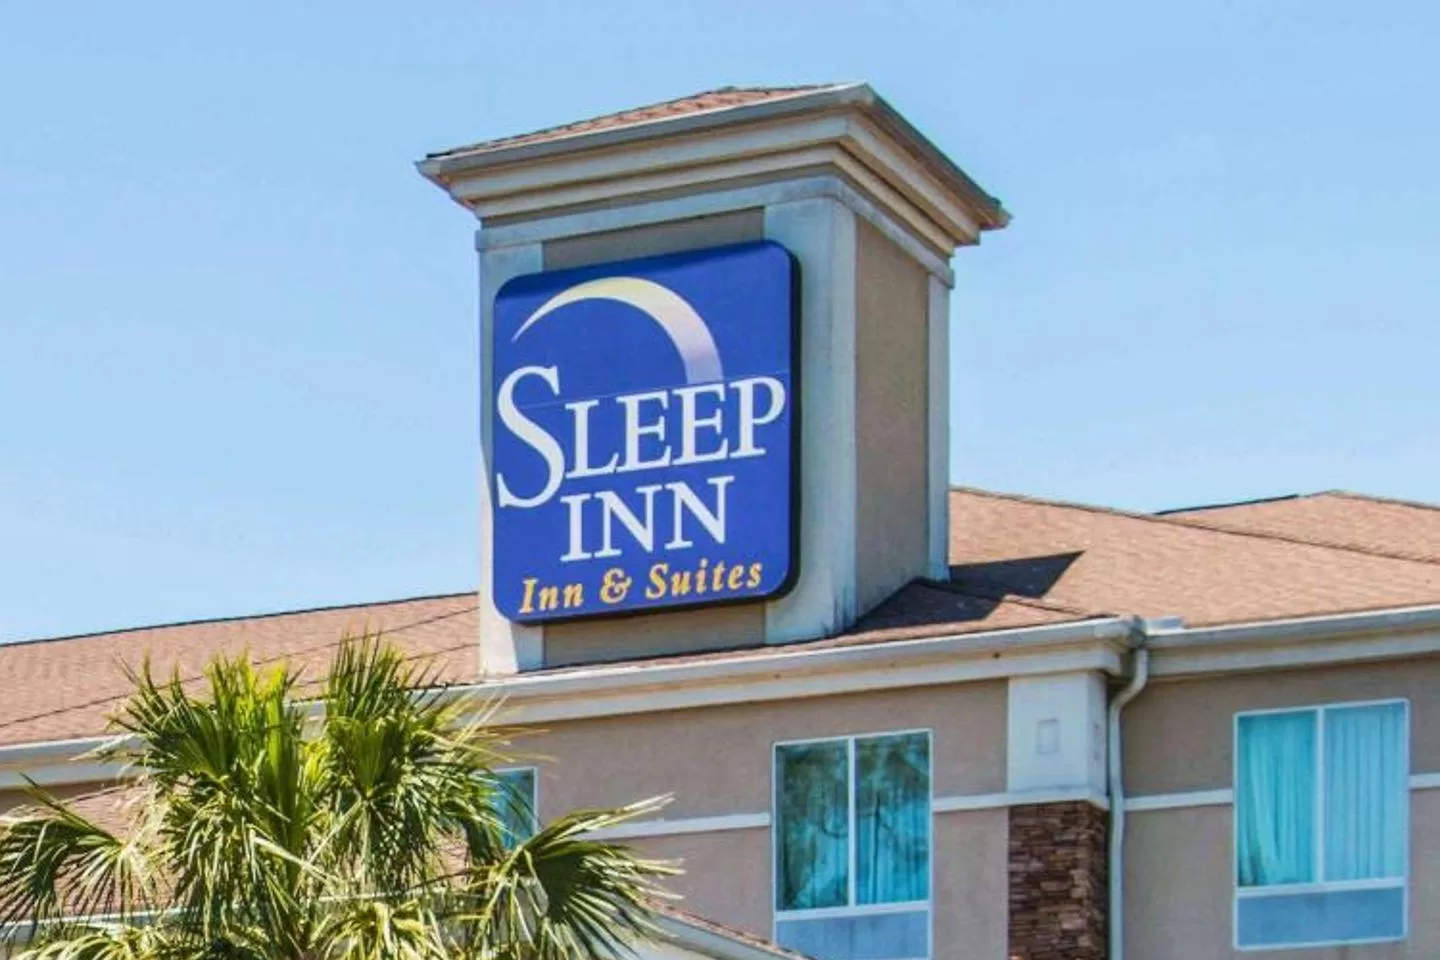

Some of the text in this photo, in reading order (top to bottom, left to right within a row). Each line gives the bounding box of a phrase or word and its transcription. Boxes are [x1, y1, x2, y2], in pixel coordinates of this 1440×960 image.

[497, 365, 785, 507] SLEEP
[560, 476, 734, 561] INN
[519, 560, 763, 613] Inn & Suites
